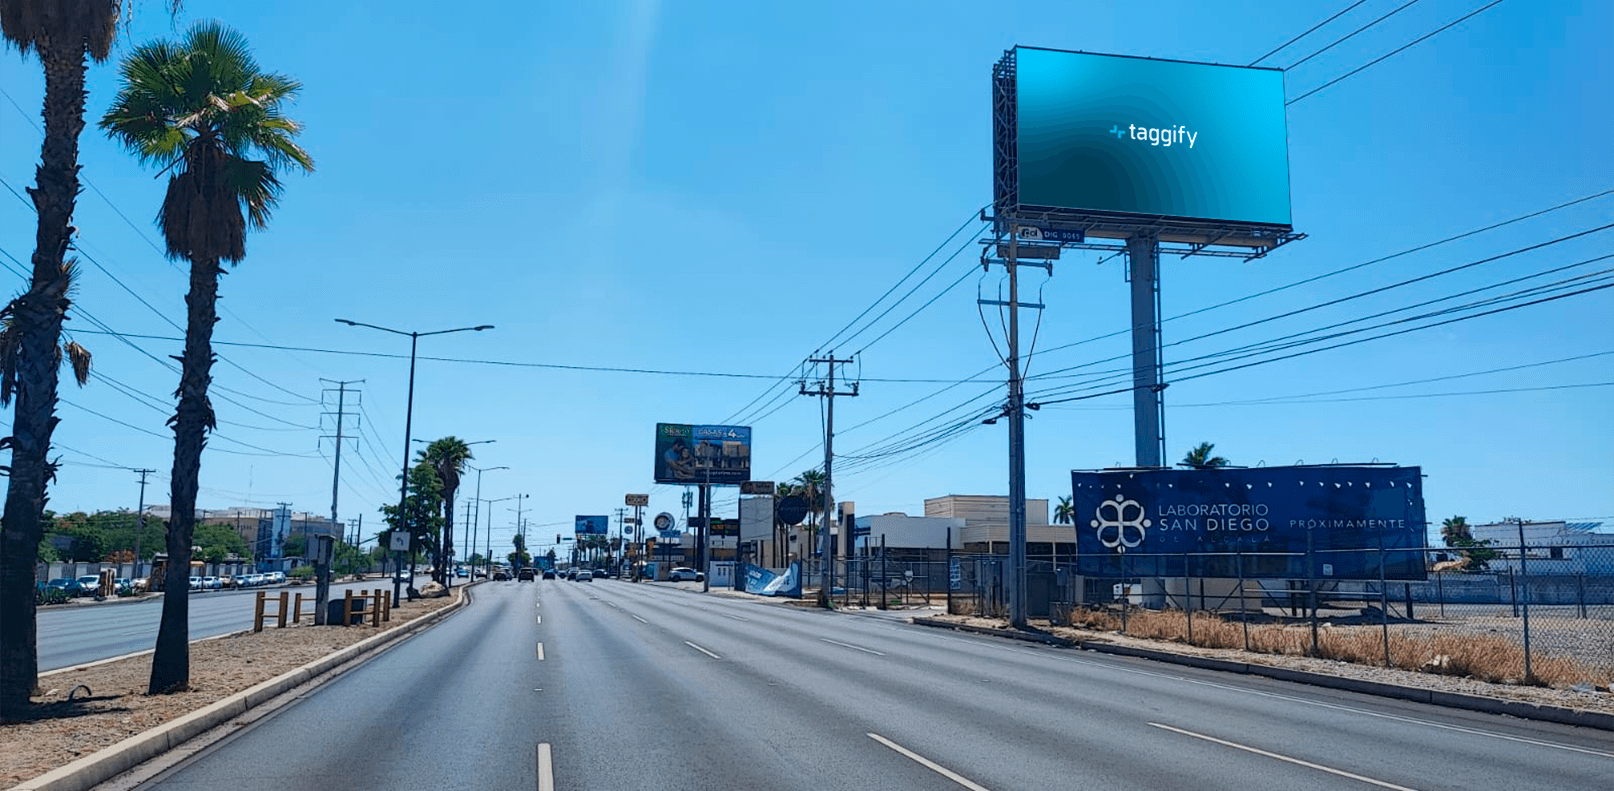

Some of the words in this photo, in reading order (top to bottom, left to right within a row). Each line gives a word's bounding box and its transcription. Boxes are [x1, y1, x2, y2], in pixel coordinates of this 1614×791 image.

[1129, 123, 1197, 148] taggify
[1158, 503, 1269, 517] LABORATORIO
[1159, 518, 1197, 532] SAN
[1206, 518, 1270, 532] DIEGO
[1289, 518, 1405, 529] PRÓXIMAMENTE
